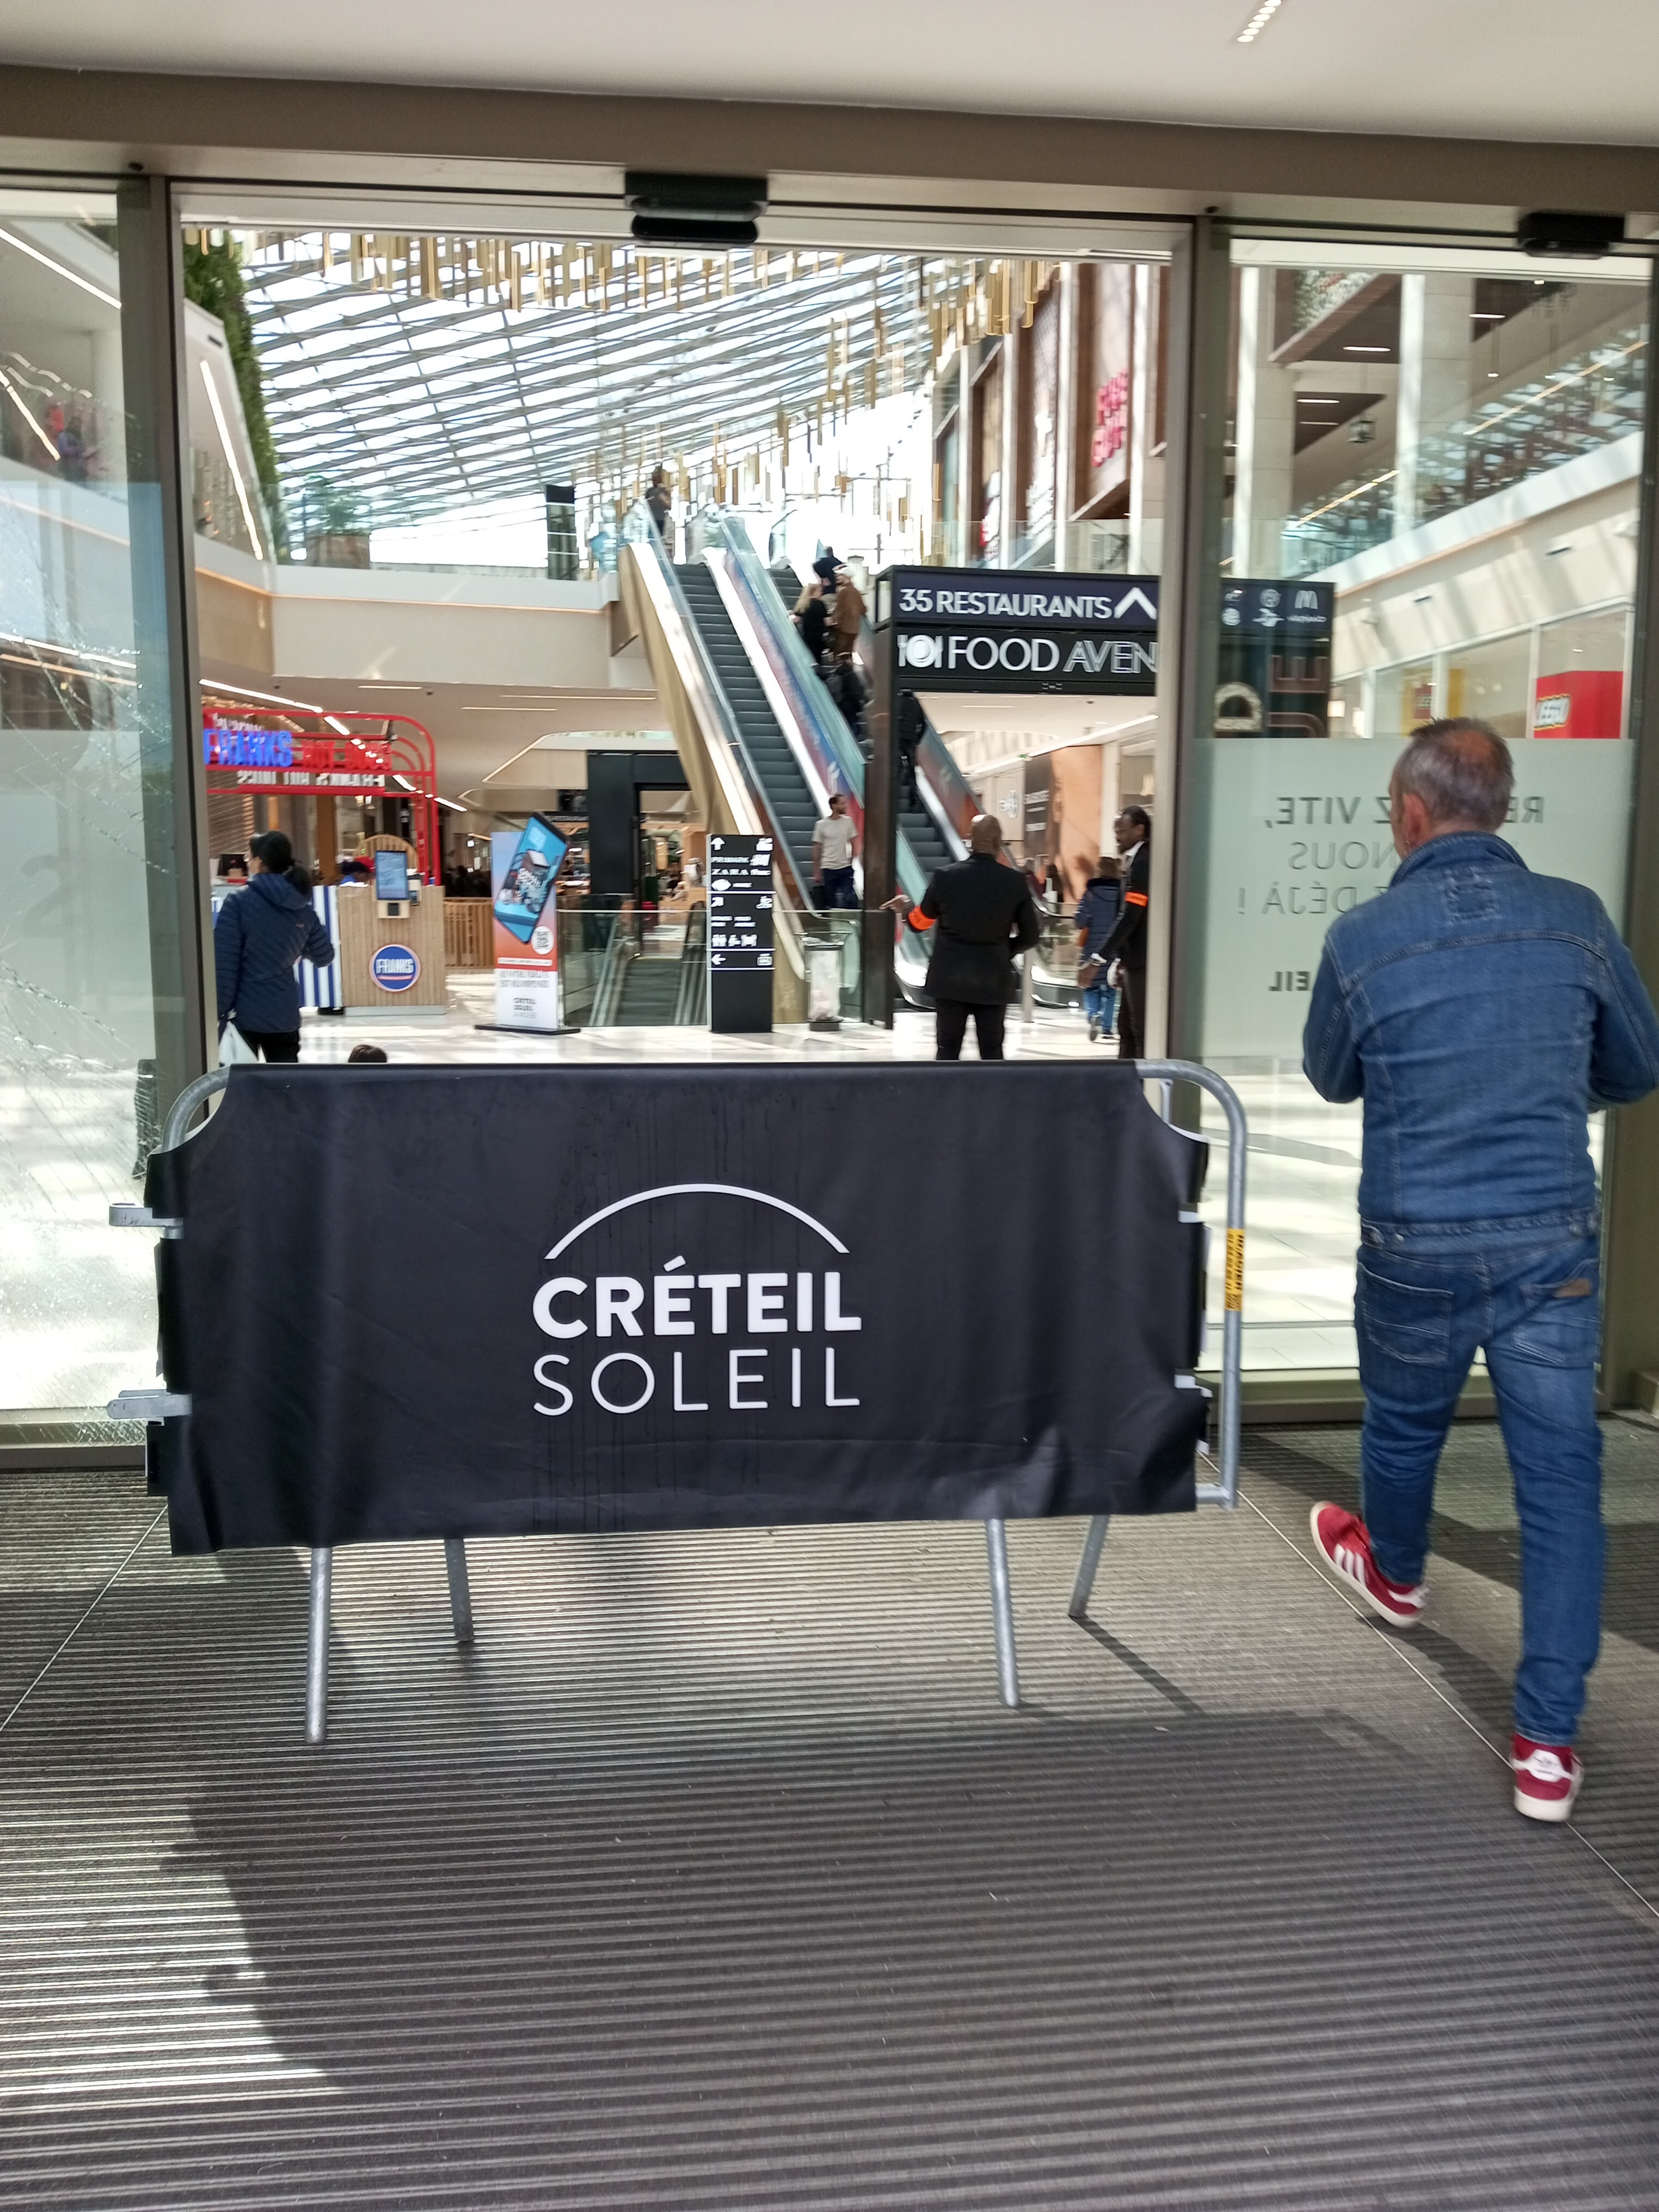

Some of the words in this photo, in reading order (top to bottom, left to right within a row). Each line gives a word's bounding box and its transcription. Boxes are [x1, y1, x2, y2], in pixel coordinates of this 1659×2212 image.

[900, 588, 933, 612] 35
[936, 591, 1113, 619] RESTAURANTS
[948, 635, 1060, 672] FOOD
[1063, 640, 1157, 674] AVEN
[203, 729, 293, 767] FRANKS
[532, 1255, 862, 1339] CRÉTEIL
[533, 1347, 861, 1416] SOLEIL
